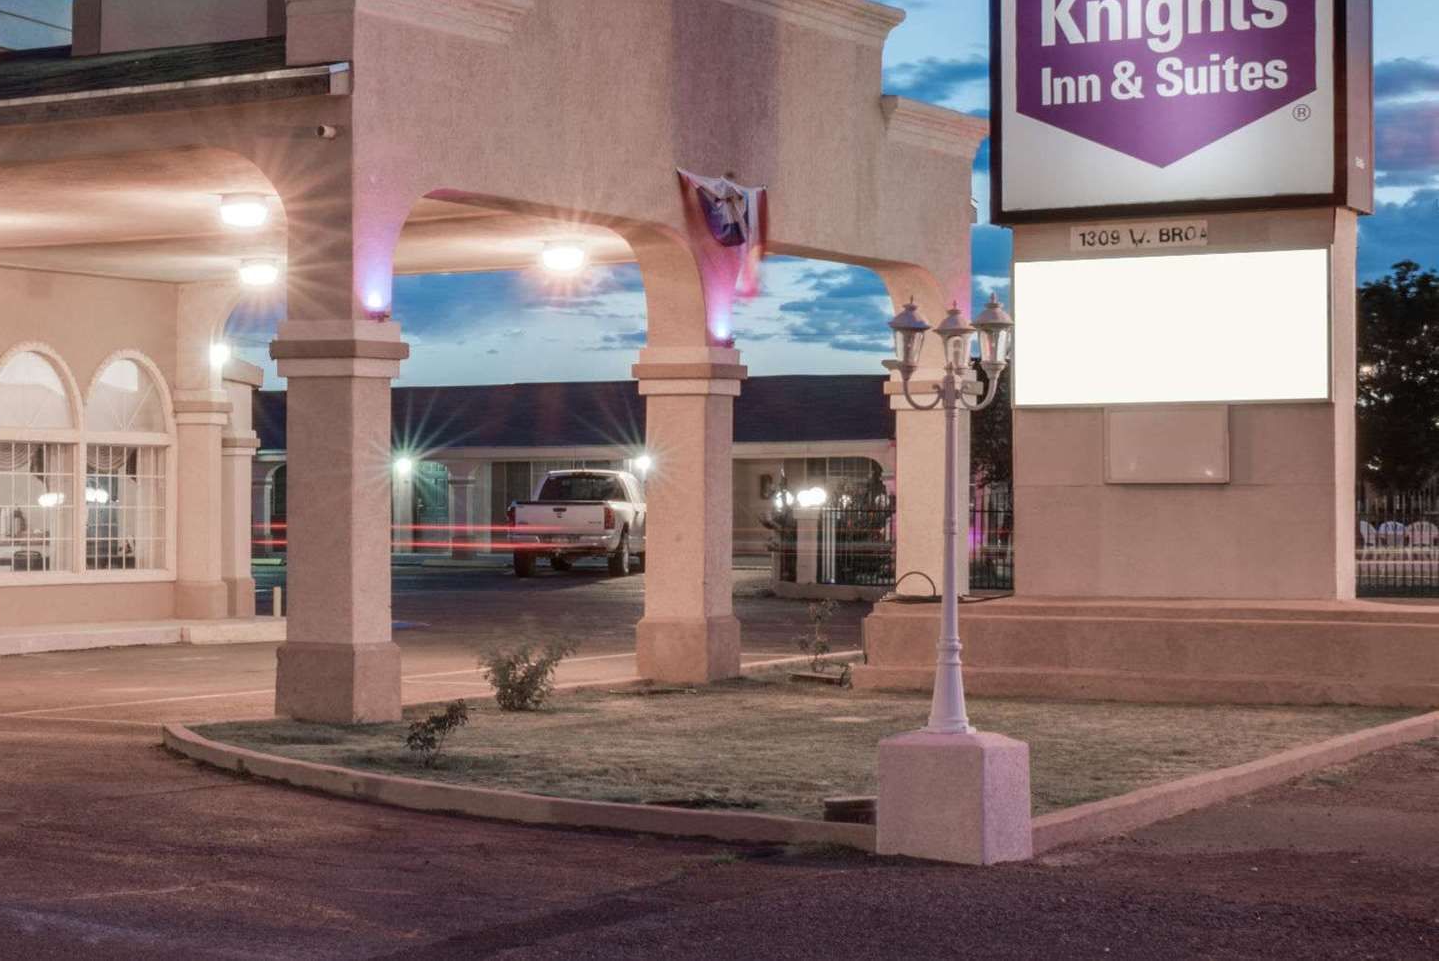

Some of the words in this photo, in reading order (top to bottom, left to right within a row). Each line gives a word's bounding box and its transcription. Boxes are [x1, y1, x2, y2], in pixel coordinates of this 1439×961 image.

[1041, 67, 1101, 106] Inn
[1110, 60, 1145, 101] &
[1155, 53, 1288, 98] Suites
[1079, 230, 1120, 247] 1309
